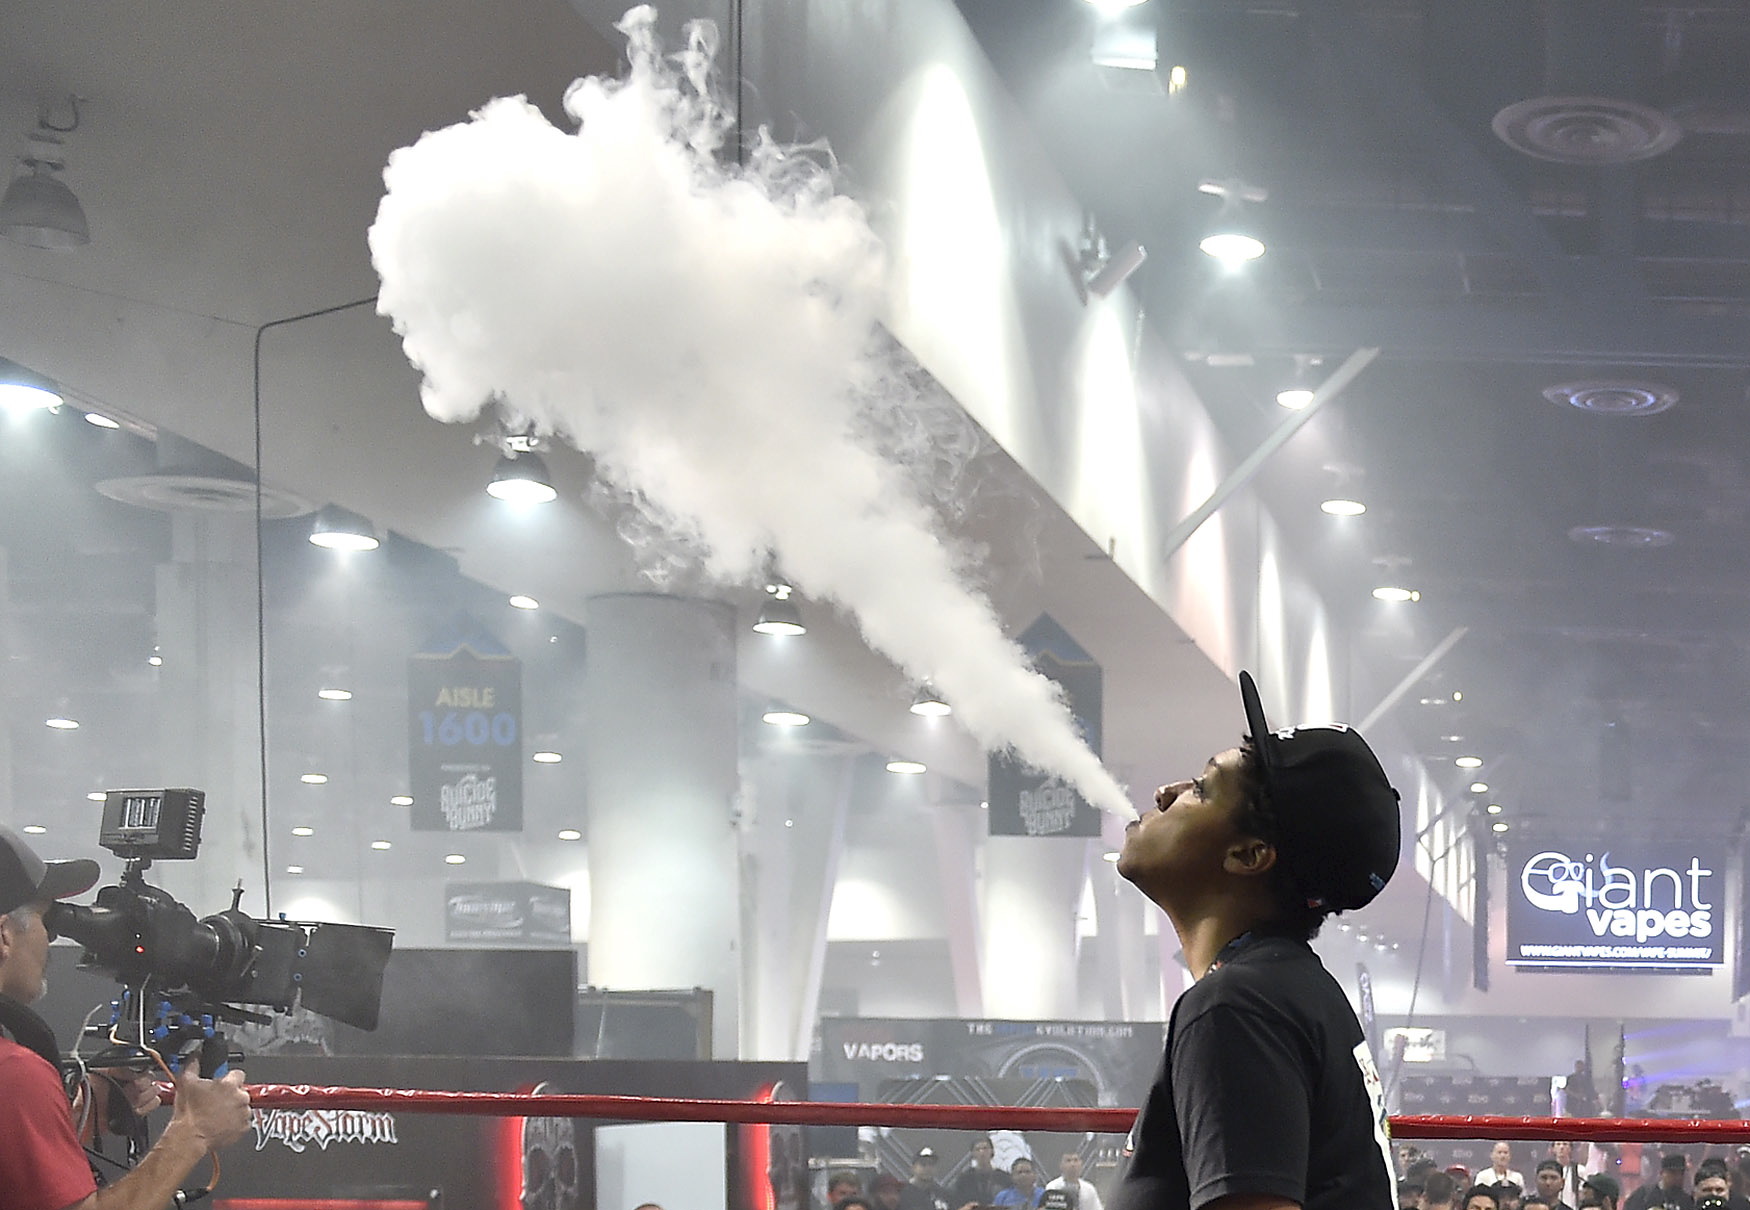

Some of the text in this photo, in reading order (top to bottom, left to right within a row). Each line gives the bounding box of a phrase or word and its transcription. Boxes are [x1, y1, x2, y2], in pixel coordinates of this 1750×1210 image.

[435, 687, 495, 708] AISLE
[417, 711, 517, 745] 1600
[1520, 852, 1713, 914] Giant
[1586, 908, 1713, 944] vapes
[843, 1043, 924, 1062] VAPORS
